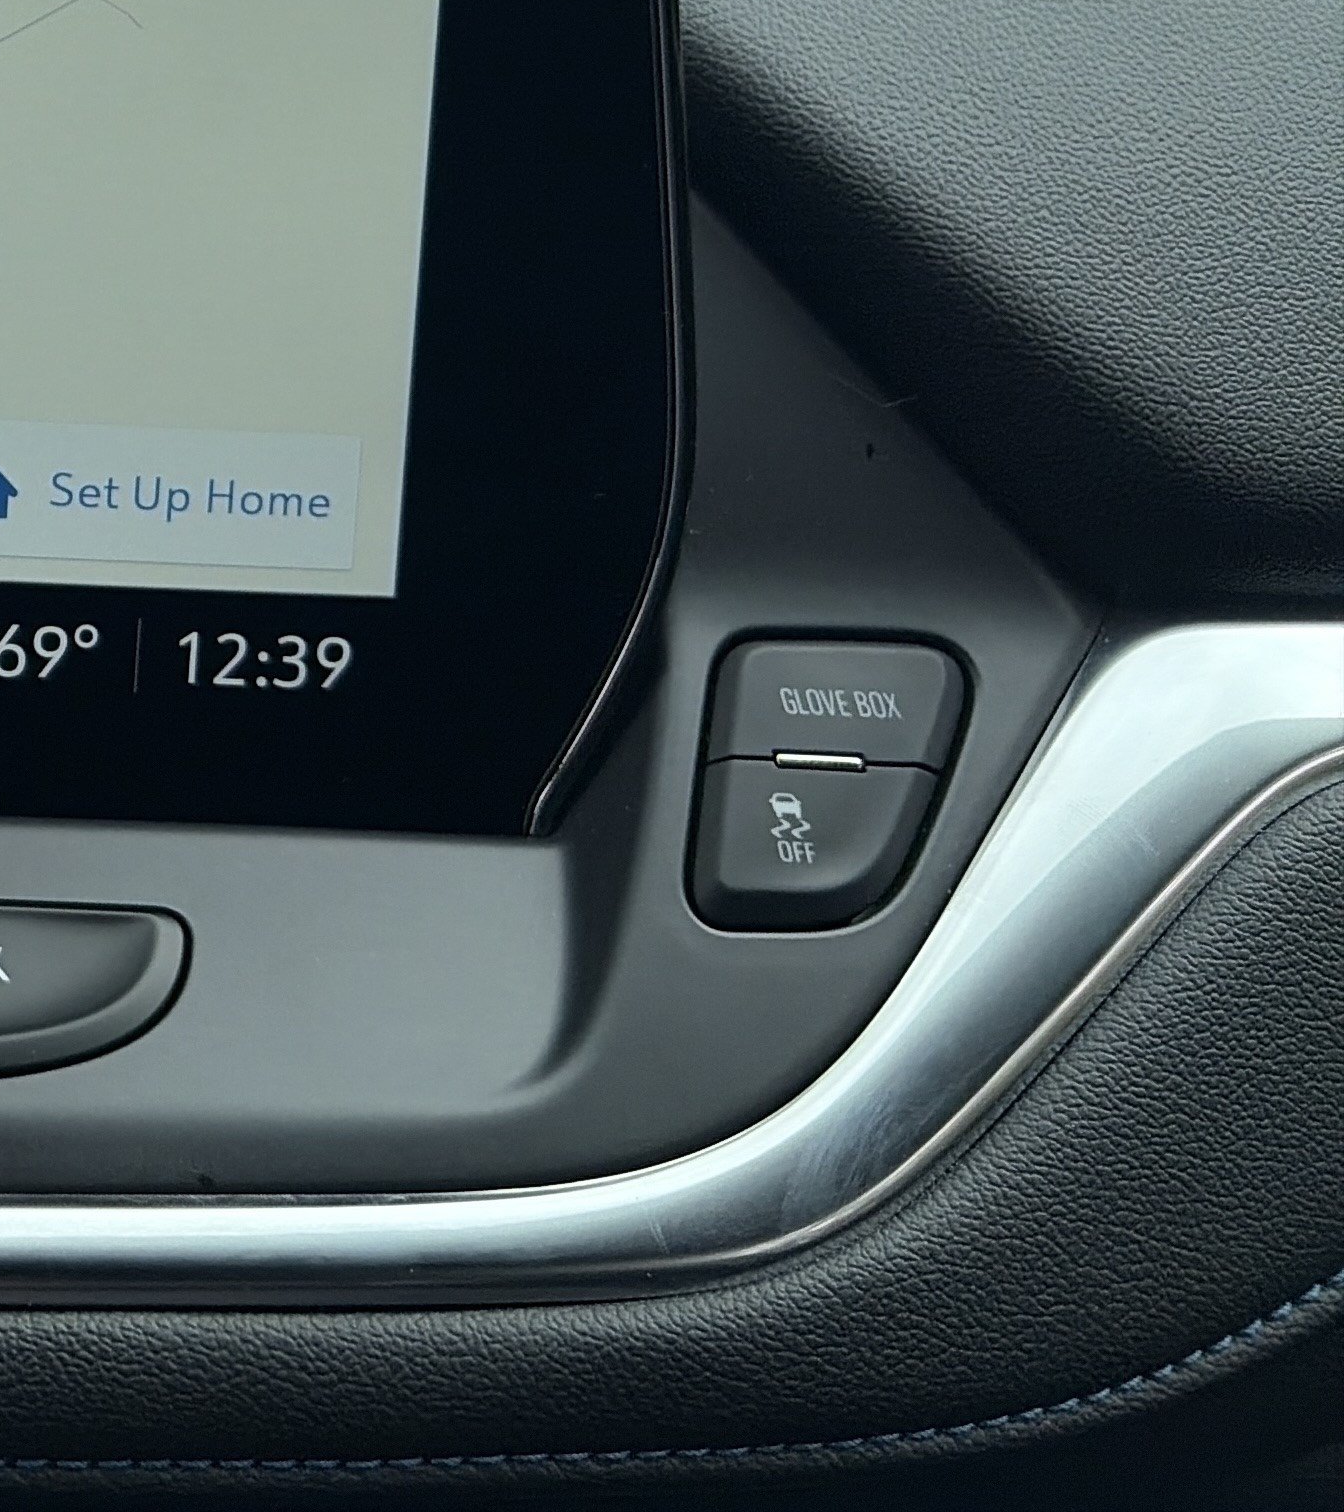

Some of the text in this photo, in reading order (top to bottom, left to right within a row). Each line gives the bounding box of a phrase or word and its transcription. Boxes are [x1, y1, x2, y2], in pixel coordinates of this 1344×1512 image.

[50, 473, 330, 522] Set Up Home
[178, 632, 353, 689] 12:39
[780, 687, 902, 719] GLOVE BOX
[777, 840, 815, 864] OFF
